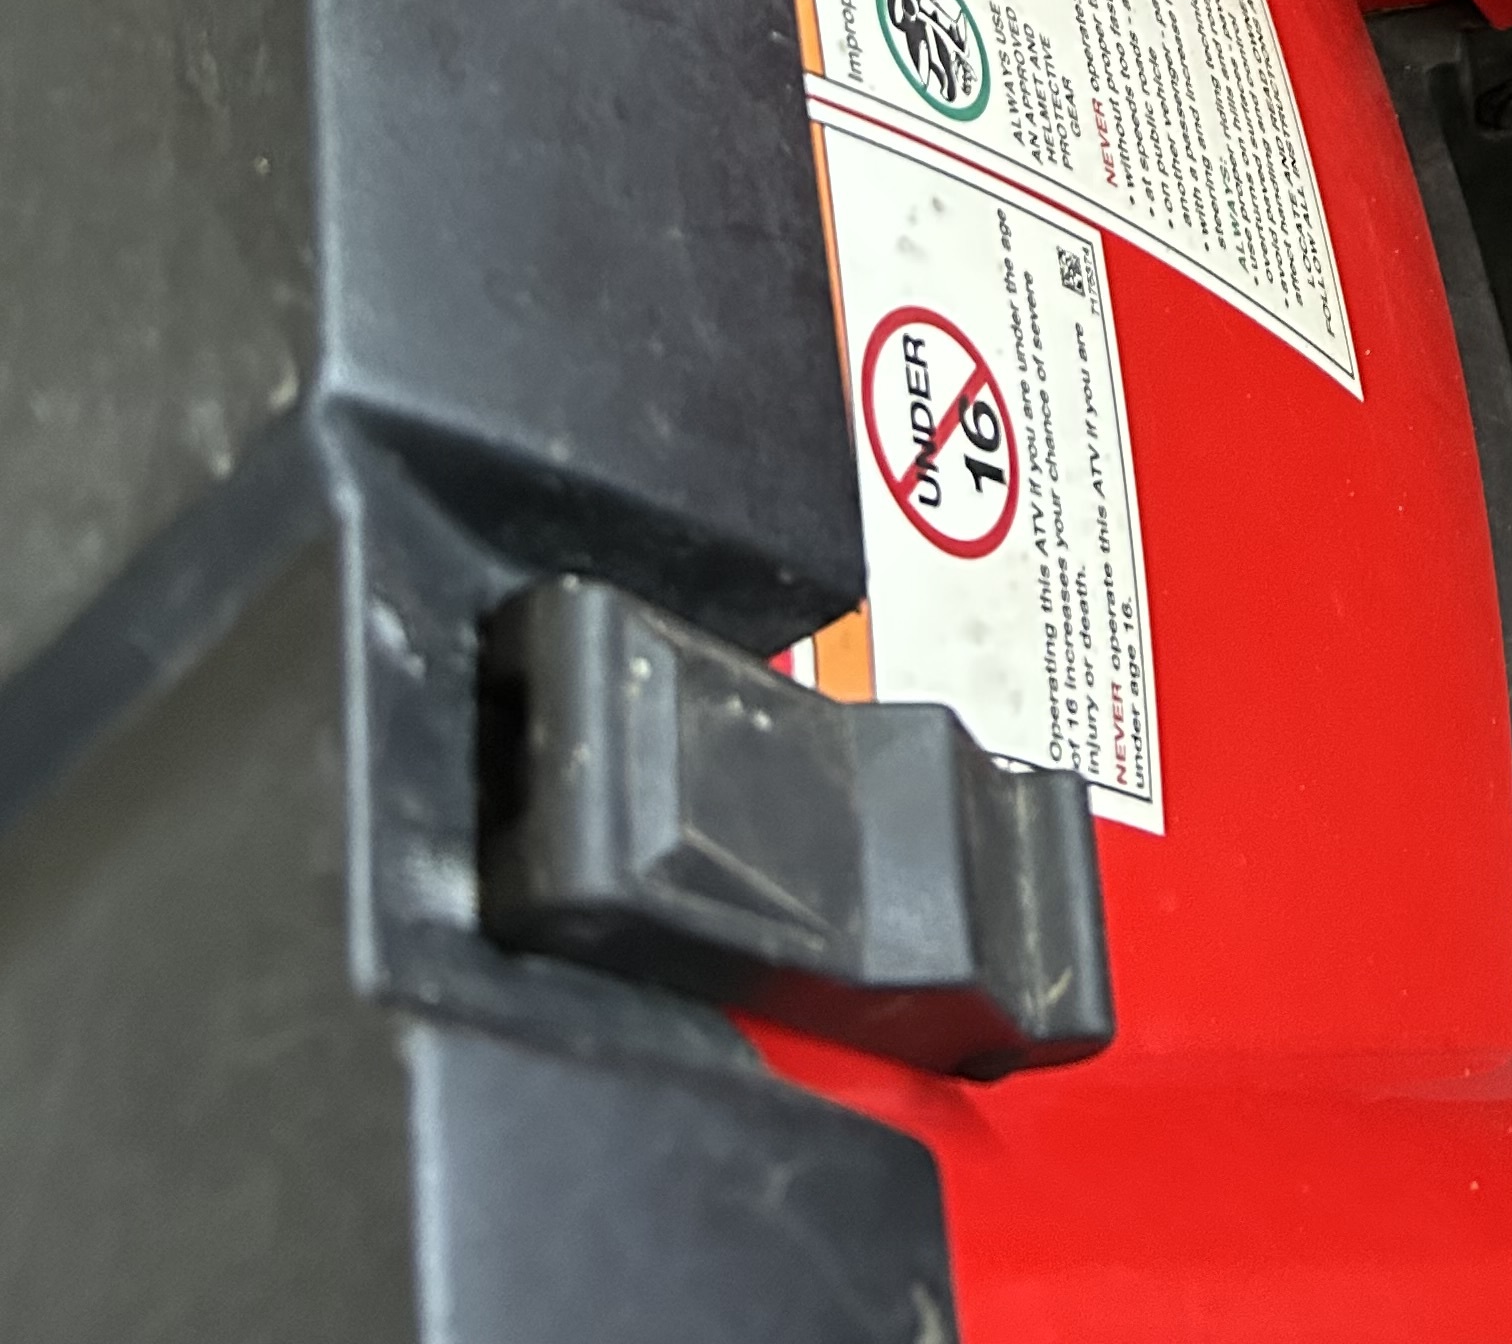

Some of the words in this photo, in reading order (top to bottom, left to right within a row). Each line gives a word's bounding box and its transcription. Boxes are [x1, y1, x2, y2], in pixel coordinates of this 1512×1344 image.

[989, 1, 1006, 45] USE
[1023, 23, 1041, 70] AND
[1093, 13, 1119, 95] proper
[1168, 10, 1195, 102] increase
[1006, 6, 1037, 127] APPROVED
[1116, 42, 1130, 80] too
[1129, 30, 1150, 96] roads
[998, 50, 1025, 146] ALWAYS
[1032, 73, 1057, 164] HELMET
[1039, 33, 1073, 171] PROTECTIVE
[1062, 76, 1081, 137] GEAR
[1125, 85, 1149, 172] speeds
[1162, 42, 1197, 163] passenger
[1189, 105, 1206, 150] and
[1028, 131, 1043, 165] AN
[1092, 98, 1118, 188] NEVER
[1109, 97, 1135, 188] without
[1145, 101, 1169, 177] public
[1142, 177, 1155, 202] at
[1161, 181, 1173, 213] on
[1167, 133, 1192, 228] another
[1202, 155, 1226, 250] steering
[997, 208, 1011, 252] age
[1288, 190, 1315, 288] LOCATE
[1004, 257, 1017, 294] the
[1307, 232, 1335, 338] FOLLOW
[1010, 300, 1027, 372] under
[1024, 271, 1042, 350] severe
[1075, 322, 1087, 362] are
[1020, 379, 1033, 420] are
[1032, 354, 1046, 382] of
[1081, 368, 1097, 416] you
[903, 335, 940, 507] UNDER
[959, 396, 1005, 491] 16
[1026, 426, 1043, 474] you
[1040, 389, 1058, 482] chance
[1085, 419, 1098, 439] if
[1029, 478, 1042, 497] if
[1088, 443, 1105, 499] ATV
[1031, 502, 1048, 557] ATV
[1051, 488, 1068, 549] your
[1097, 505, 1110, 553] this
[1038, 564, 1053, 613] this
[1075, 565, 1091, 649] death.
[1104, 562, 1121, 671] operate
[1121, 597, 1134, 632] 16.
[1058, 557, 1076, 689] increases
[1044, 623, 1064, 761] Operating
[1084, 657, 1094, 688] or
[1128, 644, 1140, 696] age
[1066, 698, 1079, 728] 16
[1086, 695, 1101, 774] injury
[1111, 681, 1127, 785] NEVER
[1131, 703, 1144, 789] under
[1068, 739, 1081, 770] of
